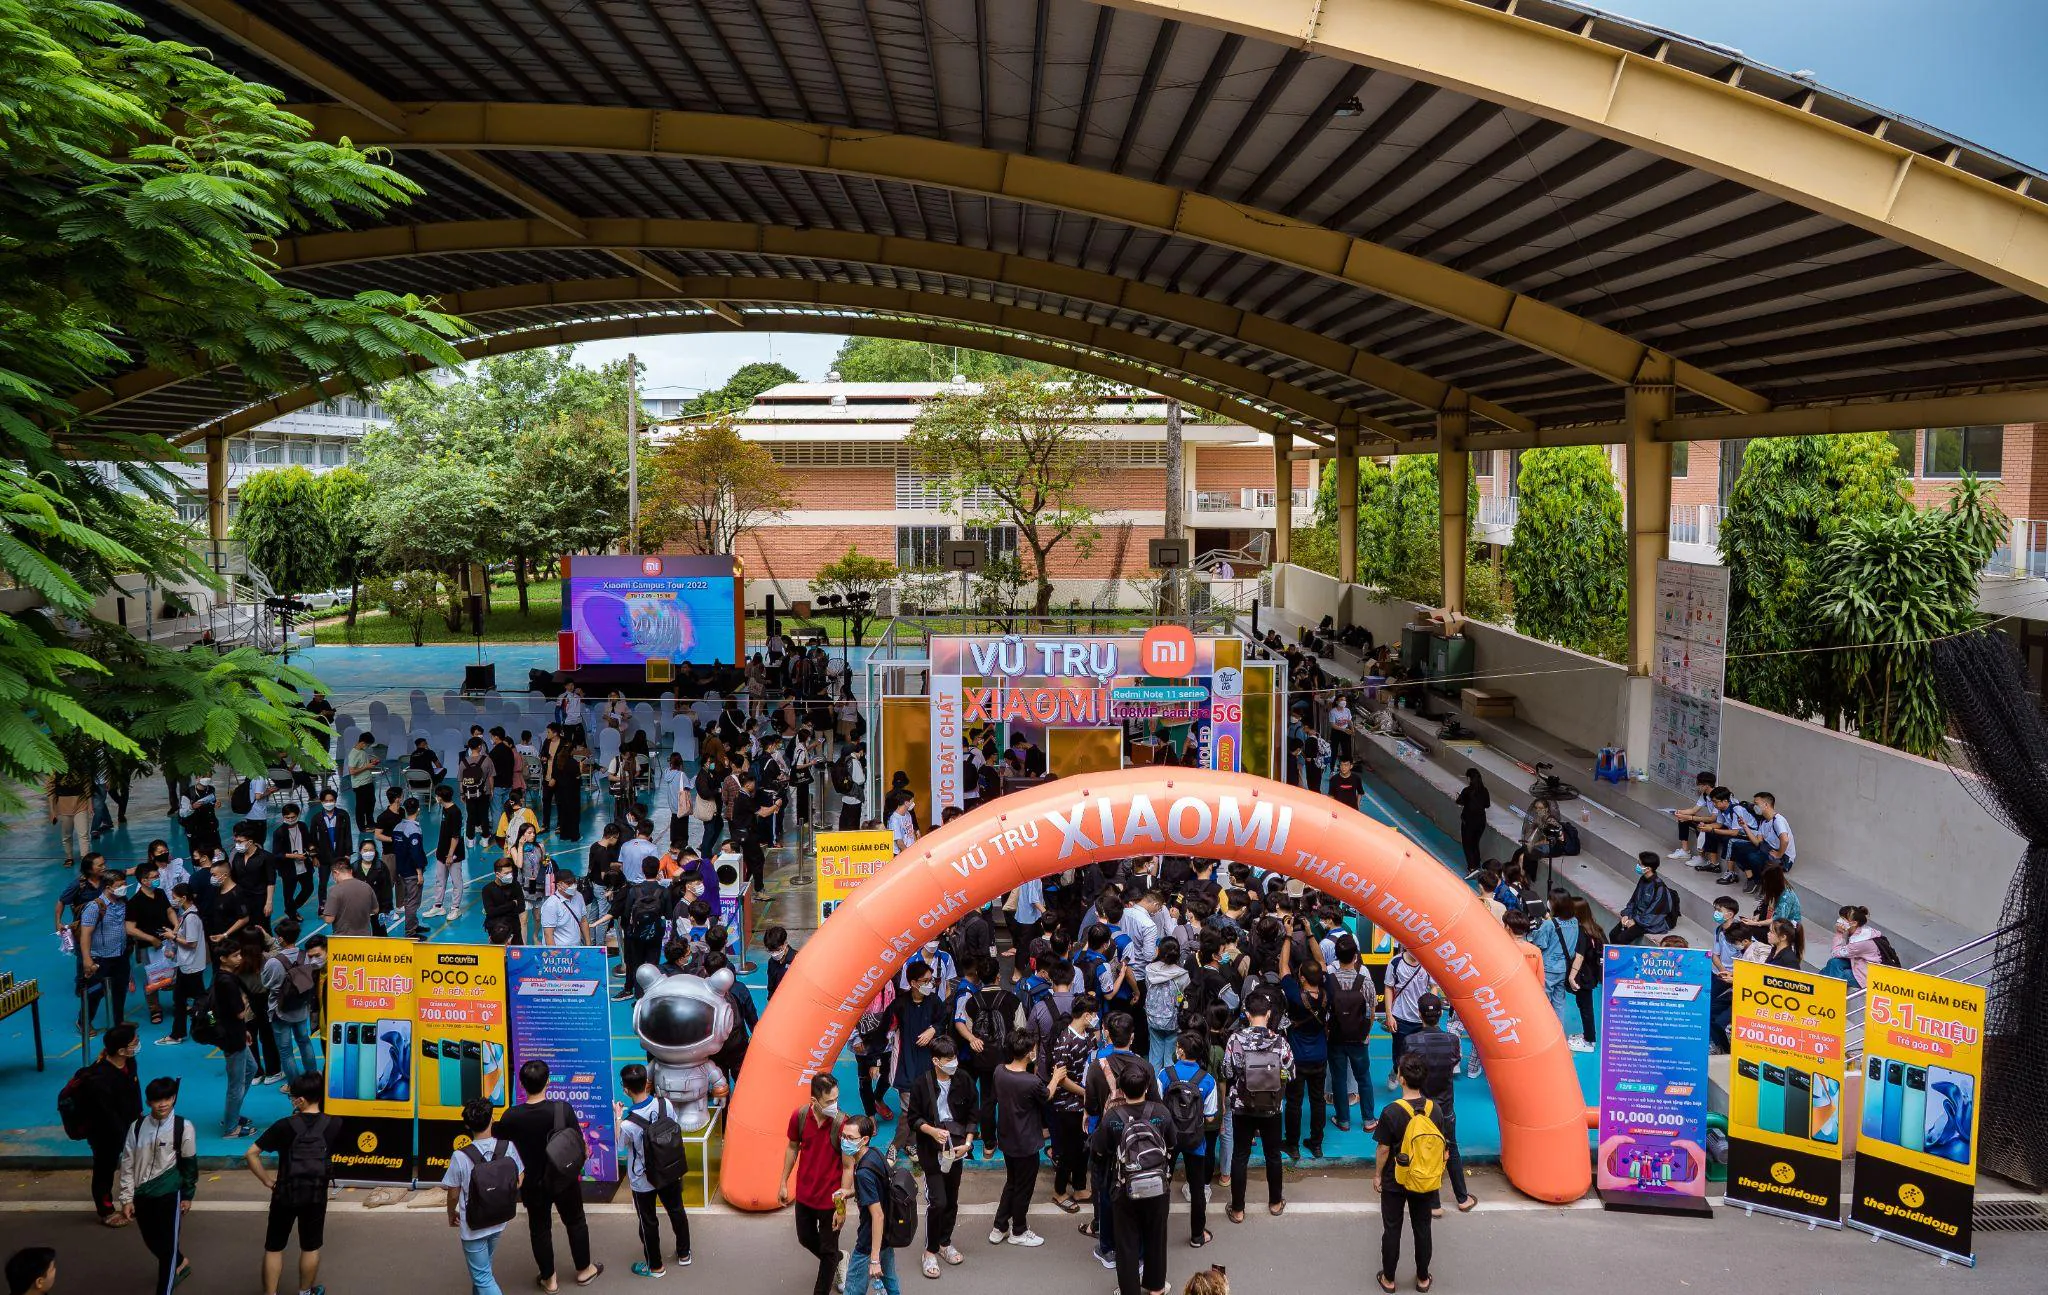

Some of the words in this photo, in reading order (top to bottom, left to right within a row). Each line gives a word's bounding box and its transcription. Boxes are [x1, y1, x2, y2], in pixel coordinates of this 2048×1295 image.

[603, 581, 631, 590] Xiaomi
[632, 581, 665, 591] Campus
[667, 581, 684, 590] Tour
[687, 581, 708, 590] 2022
[969, 634, 1028, 677] VŨ
[1034, 642, 1118, 684] TRỤ
[1113, 690, 1141, 699] Redmi
[1143, 691, 1164, 699] Note
[1178, 690, 1205, 698] series
[935, 691, 955, 738] CHẤT
[963, 687, 1111, 724] XIAOMI
[1112, 707, 1158, 718] 108MP
[1162, 708, 1211, 718] camera
[1212, 704, 1242, 724] 5G
[950, 843, 988, 878] VŨ
[988, 819, 1039, 856] TRỤ
[1043, 793, 1293, 860] XIAOMI
[820, 845, 849, 853] XIAOMI
[821, 856, 850, 877] 5.1
[721, 905, 736, 914] PHÍ
[1293, 850, 1377, 899] THÁCH
[1377, 892, 1440, 944] THỨC
[1433, 940, 1481, 982] BẬT
[1473, 985, 1522, 1045] CHẤT
[332, 953, 365, 962] XIAOMI
[367, 952, 392, 963] GIẢM
[394, 954, 413, 964] ĐẾN
[440, 956, 454, 964] ĐỘC
[421, 969, 469, 985] POCO
[474, 975, 497, 986] C40
[543, 966, 574, 974] XIAOMI
[1642, 968, 1676, 976] XIAOMI
[332, 965, 366, 992] 5.1
[367, 974, 414, 997] TRIỆU
[796, 1021, 844, 1088] THÁCH
[917, 888, 969, 929] CHẤT
[1766, 978, 1784, 988] ĐỘC
[1784, 981, 1811, 993] QUYỀN
[1741, 987, 1801, 1012] POCO
[1807, 1004, 1836, 1020] C40
[1872, 980, 1914, 998] XIAOMI
[1917, 989, 1950, 1006] GIẢM
[1951, 998, 1978, 1013] ĐẾN
[420, 1008, 467, 1021] 700.000
[1870, 994, 1914, 1031] 5.1
[1915, 1015, 1978, 1045] TRIỆU
[1738, 1026, 1796, 1048] 700.000
[1896, 1035, 1910, 1046] Trả
[1912, 1040, 1929, 1050] góp
[1608, 1110, 1684, 1126] 10,000,000
[331, 1153, 404, 1169] thegioididong
[1737, 1176, 1829, 1206] thegioididong
[1863, 1196, 1960, 1237] thegioididong
